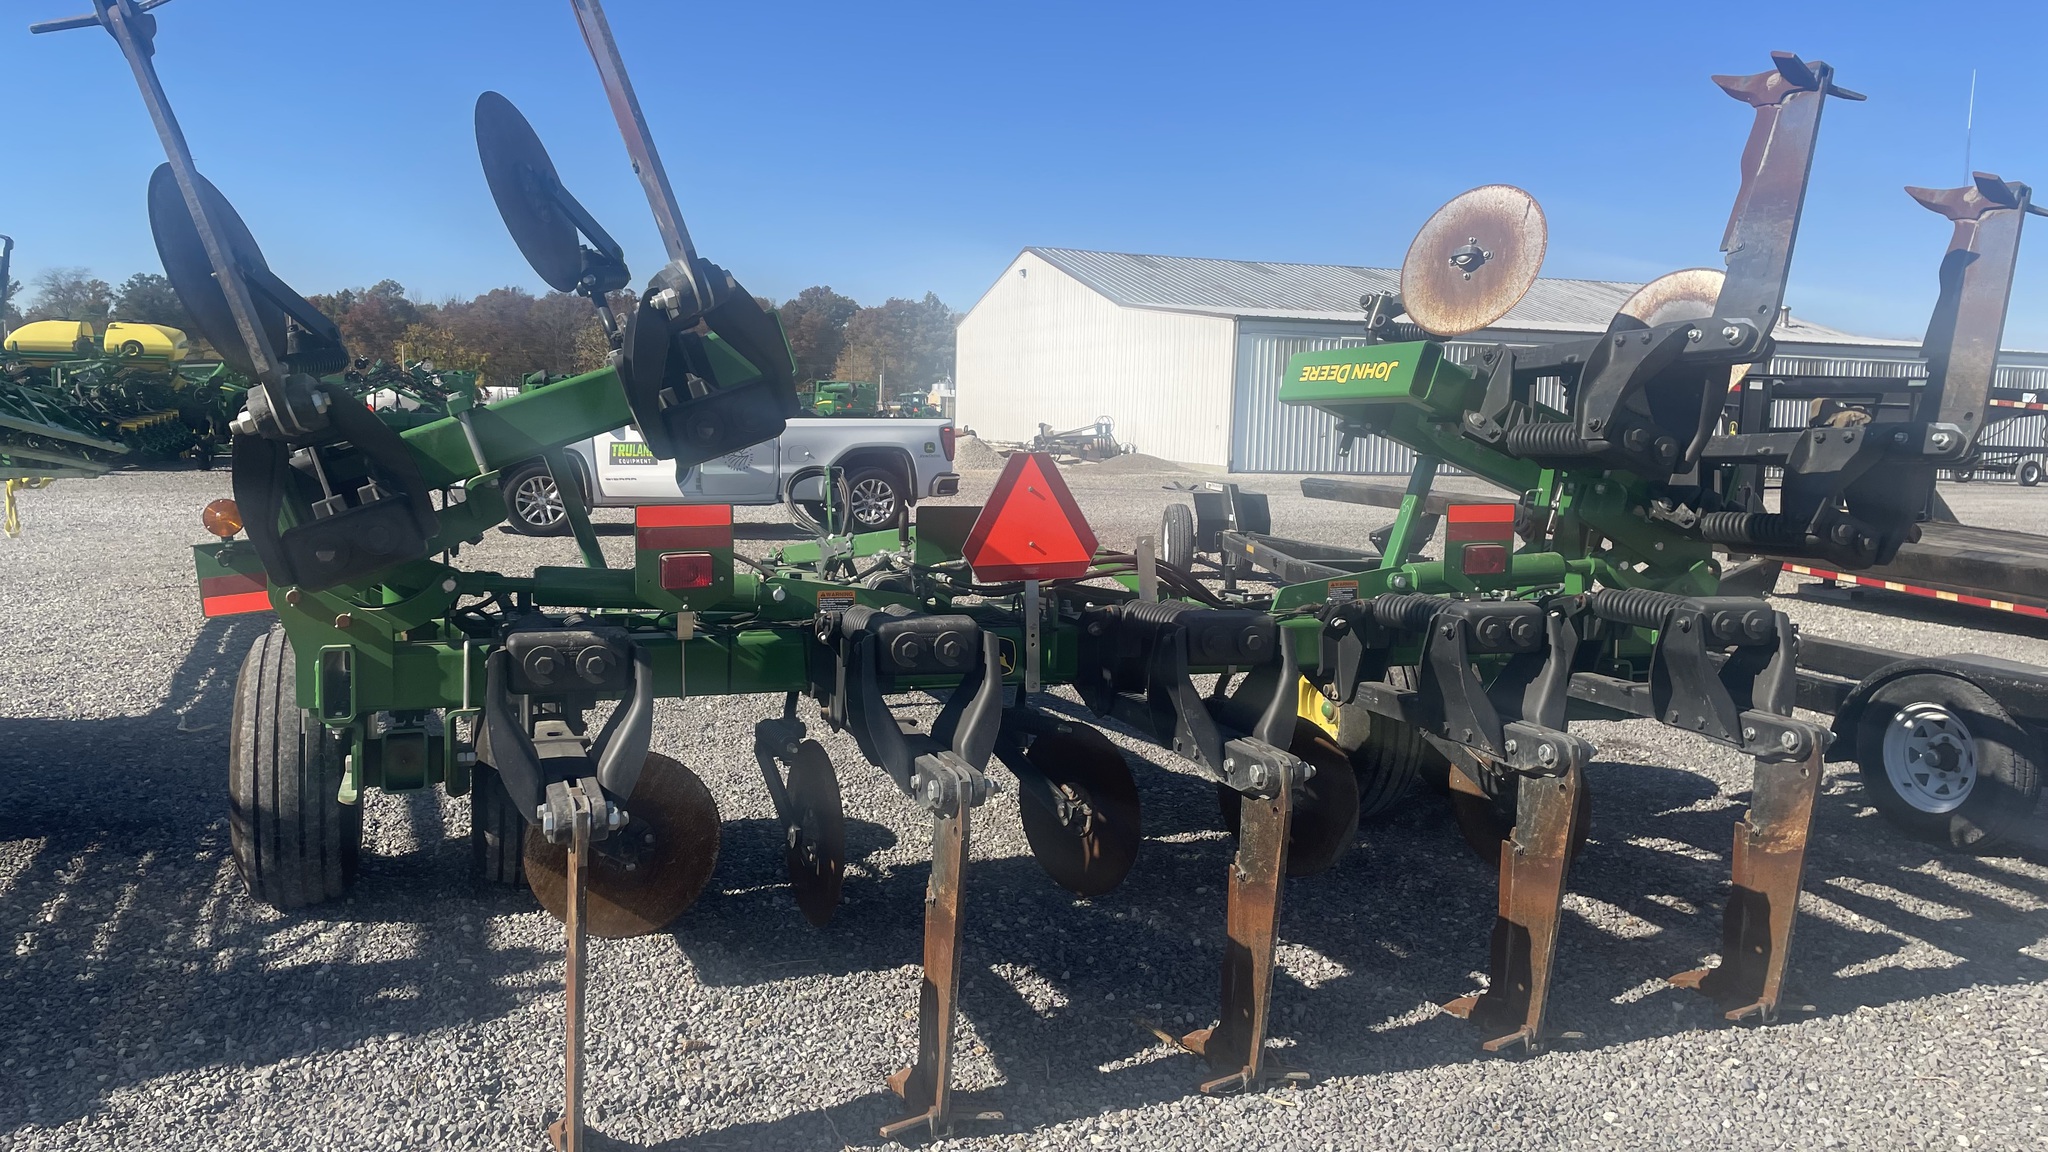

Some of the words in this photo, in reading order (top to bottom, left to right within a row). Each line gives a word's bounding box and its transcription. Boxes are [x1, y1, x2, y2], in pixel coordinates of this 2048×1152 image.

[1298, 363, 1352, 384] DEERE
[1351, 360, 1399, 382] JOHN
[611, 443, 653, 457] TRULAN
